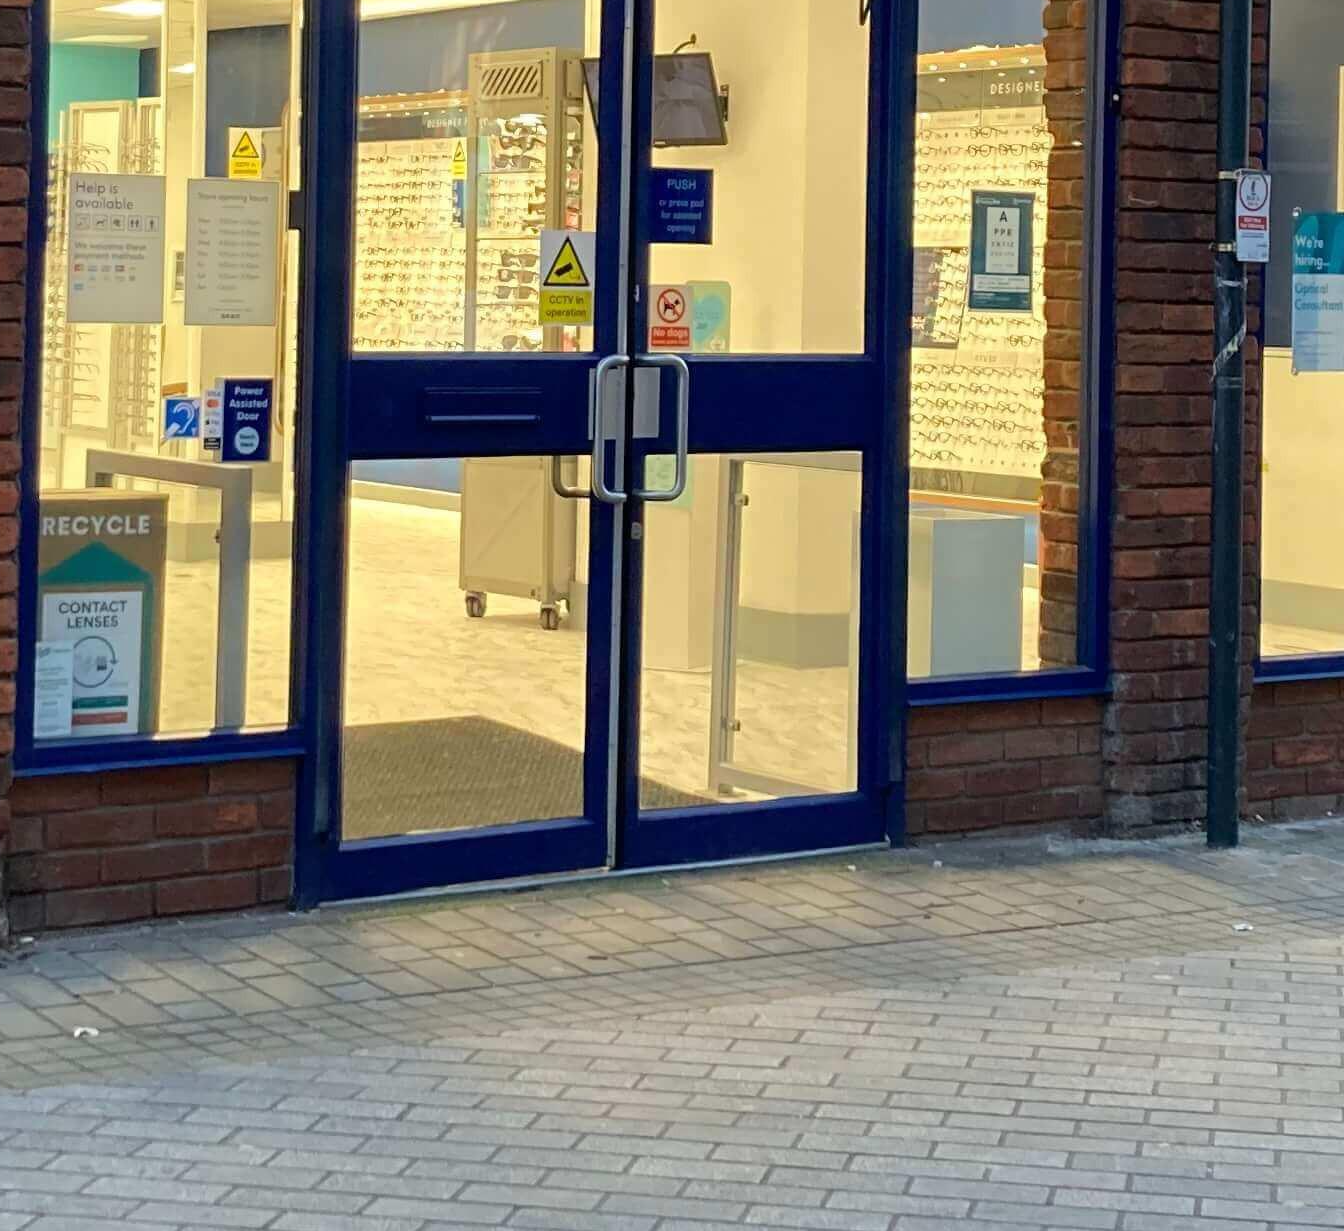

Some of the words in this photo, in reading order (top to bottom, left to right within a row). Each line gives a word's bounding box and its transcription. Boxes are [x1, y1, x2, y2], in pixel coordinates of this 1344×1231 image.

[990, 80, 1042, 96] DESIGNE
[75, 181, 106, 197] Help
[109, 182, 120, 194] is
[666, 178, 697, 190] PUSH
[74, 196, 135, 210] available
[548, 295, 574, 305] CCTV
[545, 308, 587, 319] operation
[234, 385, 265, 397] Power
[229, 398, 269, 408] Assisted
[236, 411, 260, 421] Door
[42, 514, 151, 537] RECYCLE
[58, 599, 128, 615] CONTACT
[66, 614, 120, 630] LENSES
